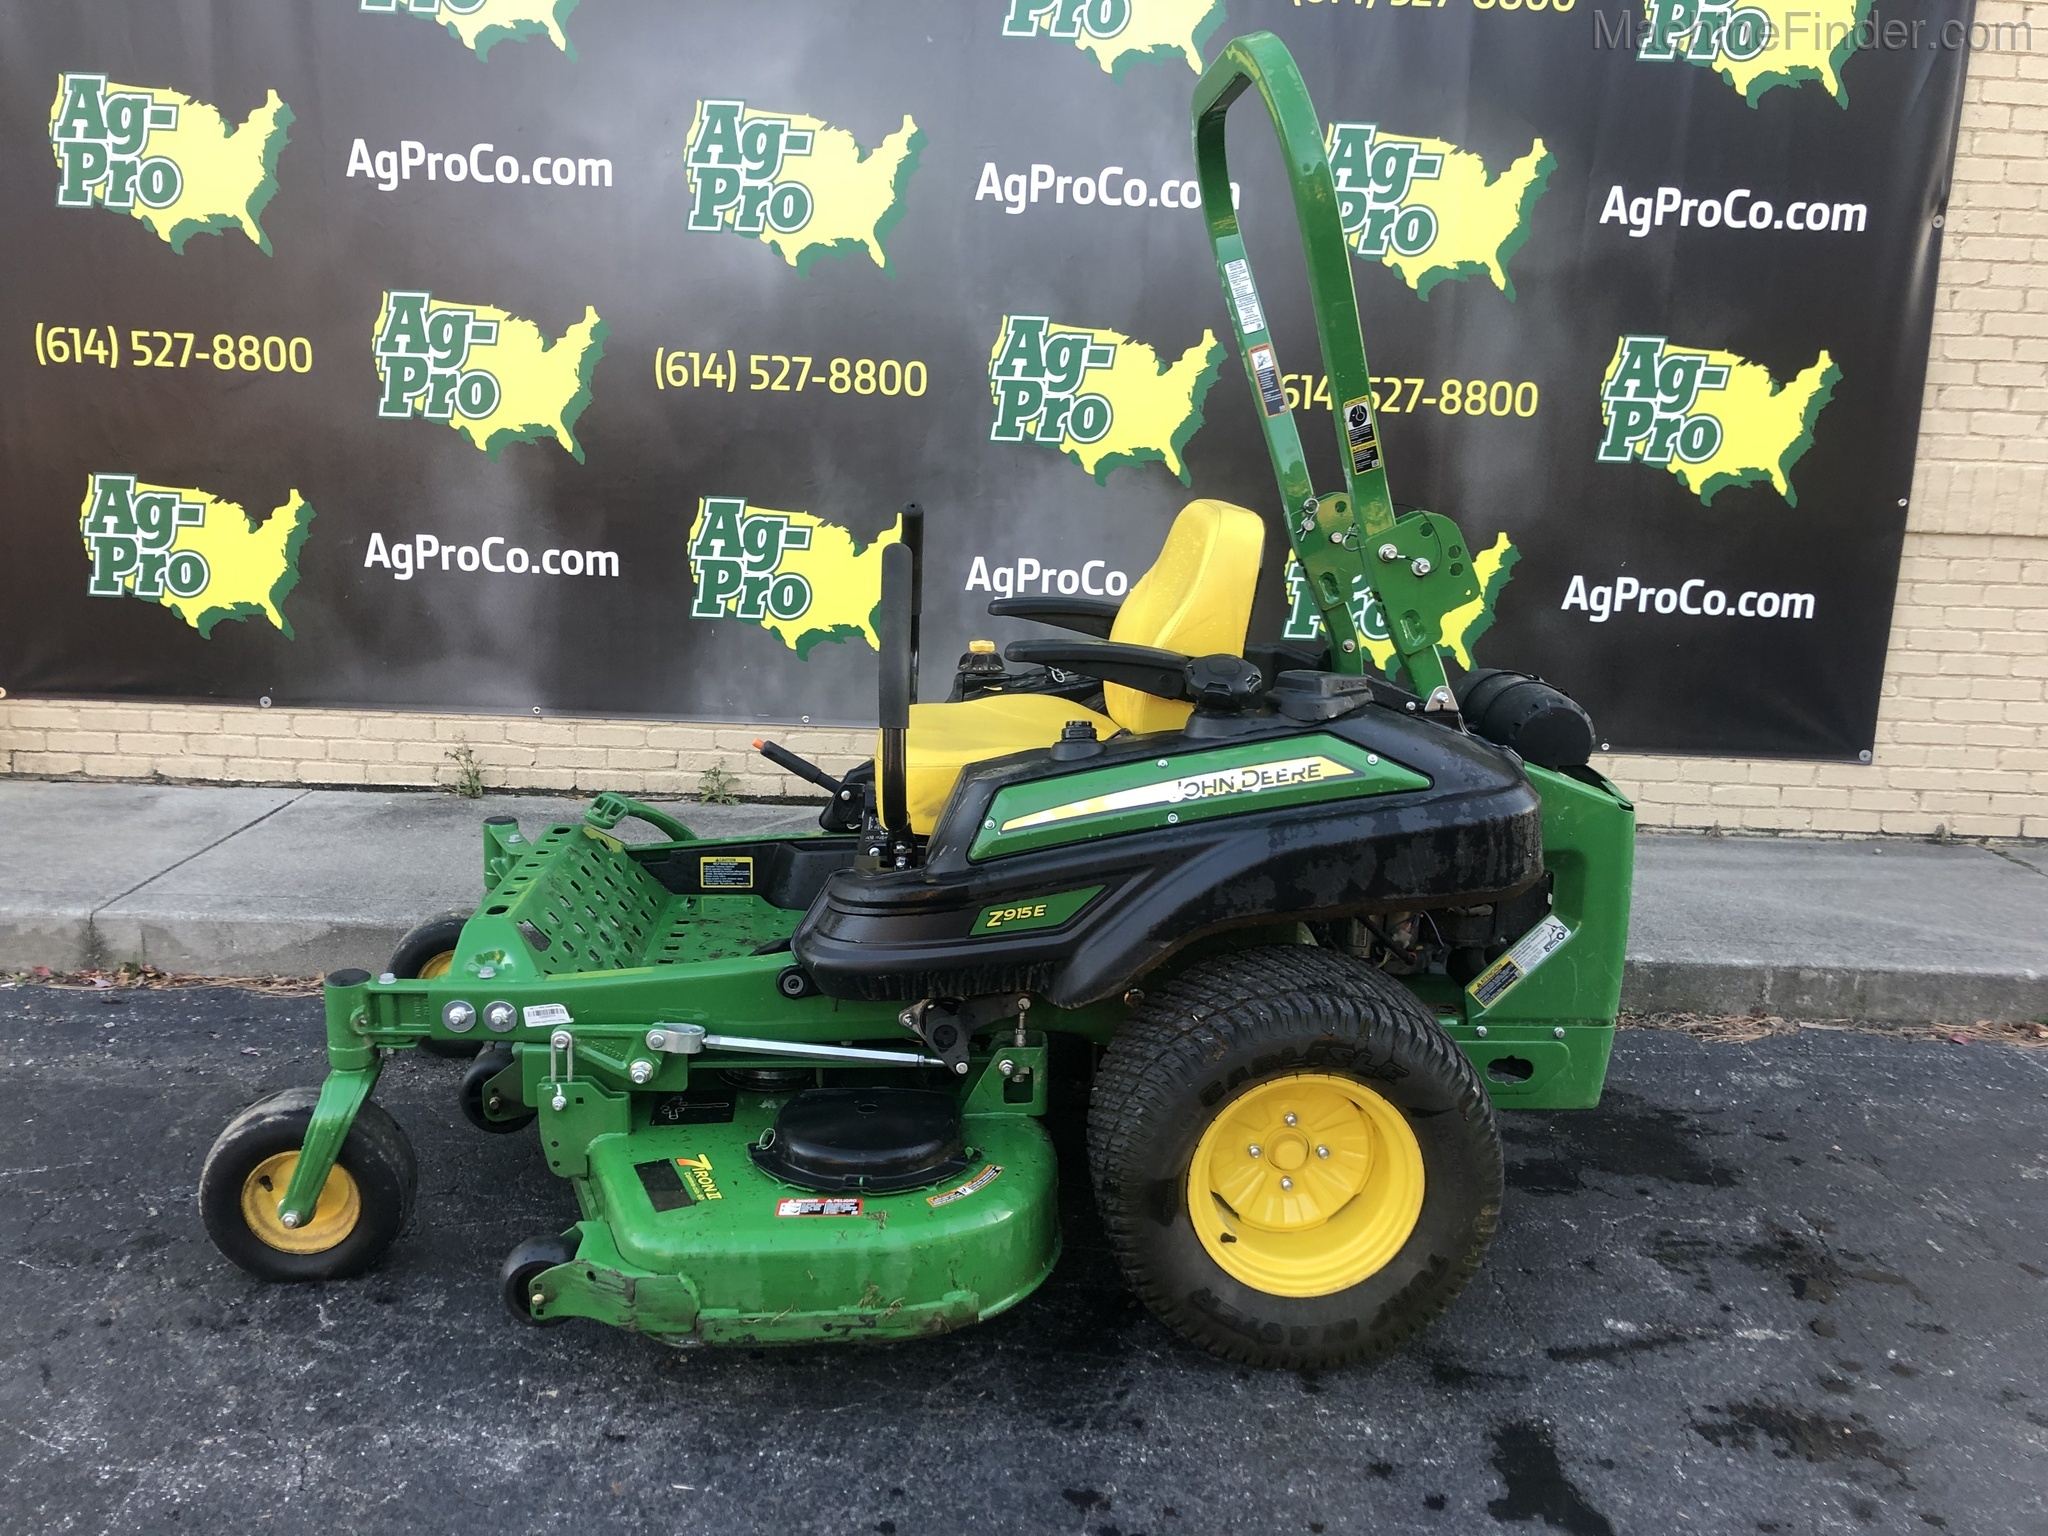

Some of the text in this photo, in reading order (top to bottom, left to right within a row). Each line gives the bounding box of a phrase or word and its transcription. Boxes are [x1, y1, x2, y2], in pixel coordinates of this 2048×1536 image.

[1639, 0, 1769, 60] Pro
[53, 74, 178, 157] Ag-
[687, 100, 813, 182] Ag-
[58, 141, 182, 207] Pro
[347, 139, 612, 191] AgProCo.com
[1329, 124, 1442, 206] Ag-
[687, 166, 812, 232] Pro
[1336, 189, 1437, 255] Pro
[1600, 185, 1866, 237] AgProCo.com
[36, 323, 312, 373] (614) 527-8800
[376, 292, 497, 371] Ag-
[992, 315, 1115, 395] Ag-
[379, 355, 500, 418] Pro
[655, 347, 927, 397] (614) 527-8800
[1368, 377, 1539, 417] 527-8800
[1603, 337, 1730, 416] Ag-
[990, 379, 1112, 442] Pro
[1598, 399, 1721, 462] Pro
[84, 475, 204, 552] Ag-
[691, 498, 812, 575] Ag-
[89, 535, 208, 597] Pro
[365, 533, 618, 580] AgProCo.com
[692, 557, 811, 619] Pro
[1562, 575, 1814, 622] AgProCo.com
[1242, 763, 1321, 788] DEERE
